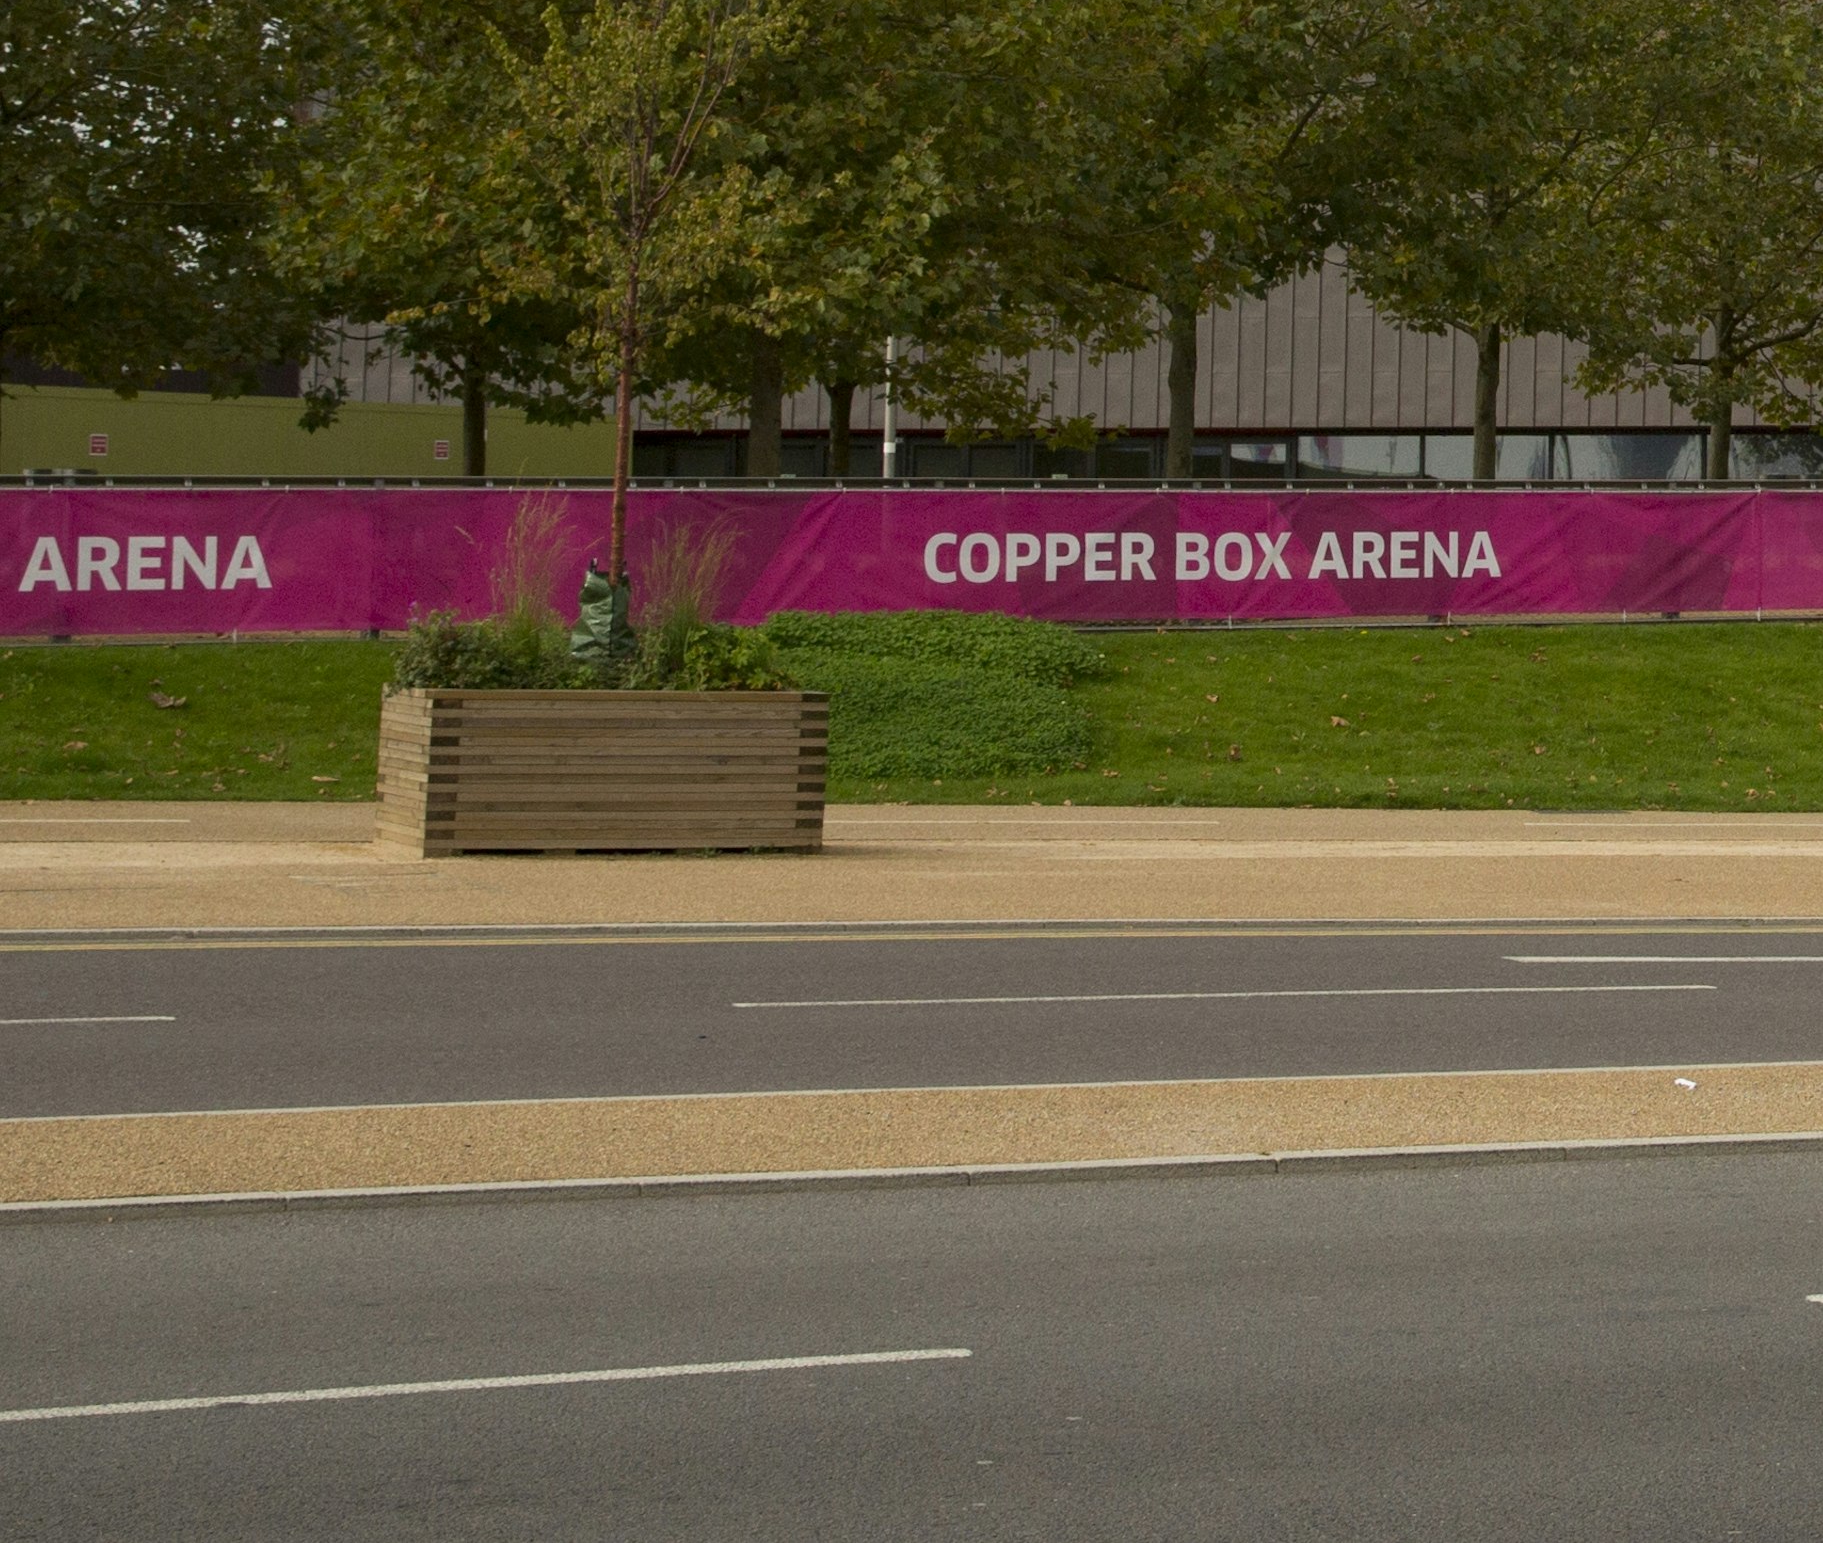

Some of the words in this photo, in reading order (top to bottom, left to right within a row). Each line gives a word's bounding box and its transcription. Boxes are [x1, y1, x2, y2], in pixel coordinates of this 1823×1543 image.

[19, 535, 271, 591] ARENA
[924, 532, 1156, 583] COPPER
[1176, 532, 1291, 581] BOX
[1308, 531, 1501, 578] ARENA
